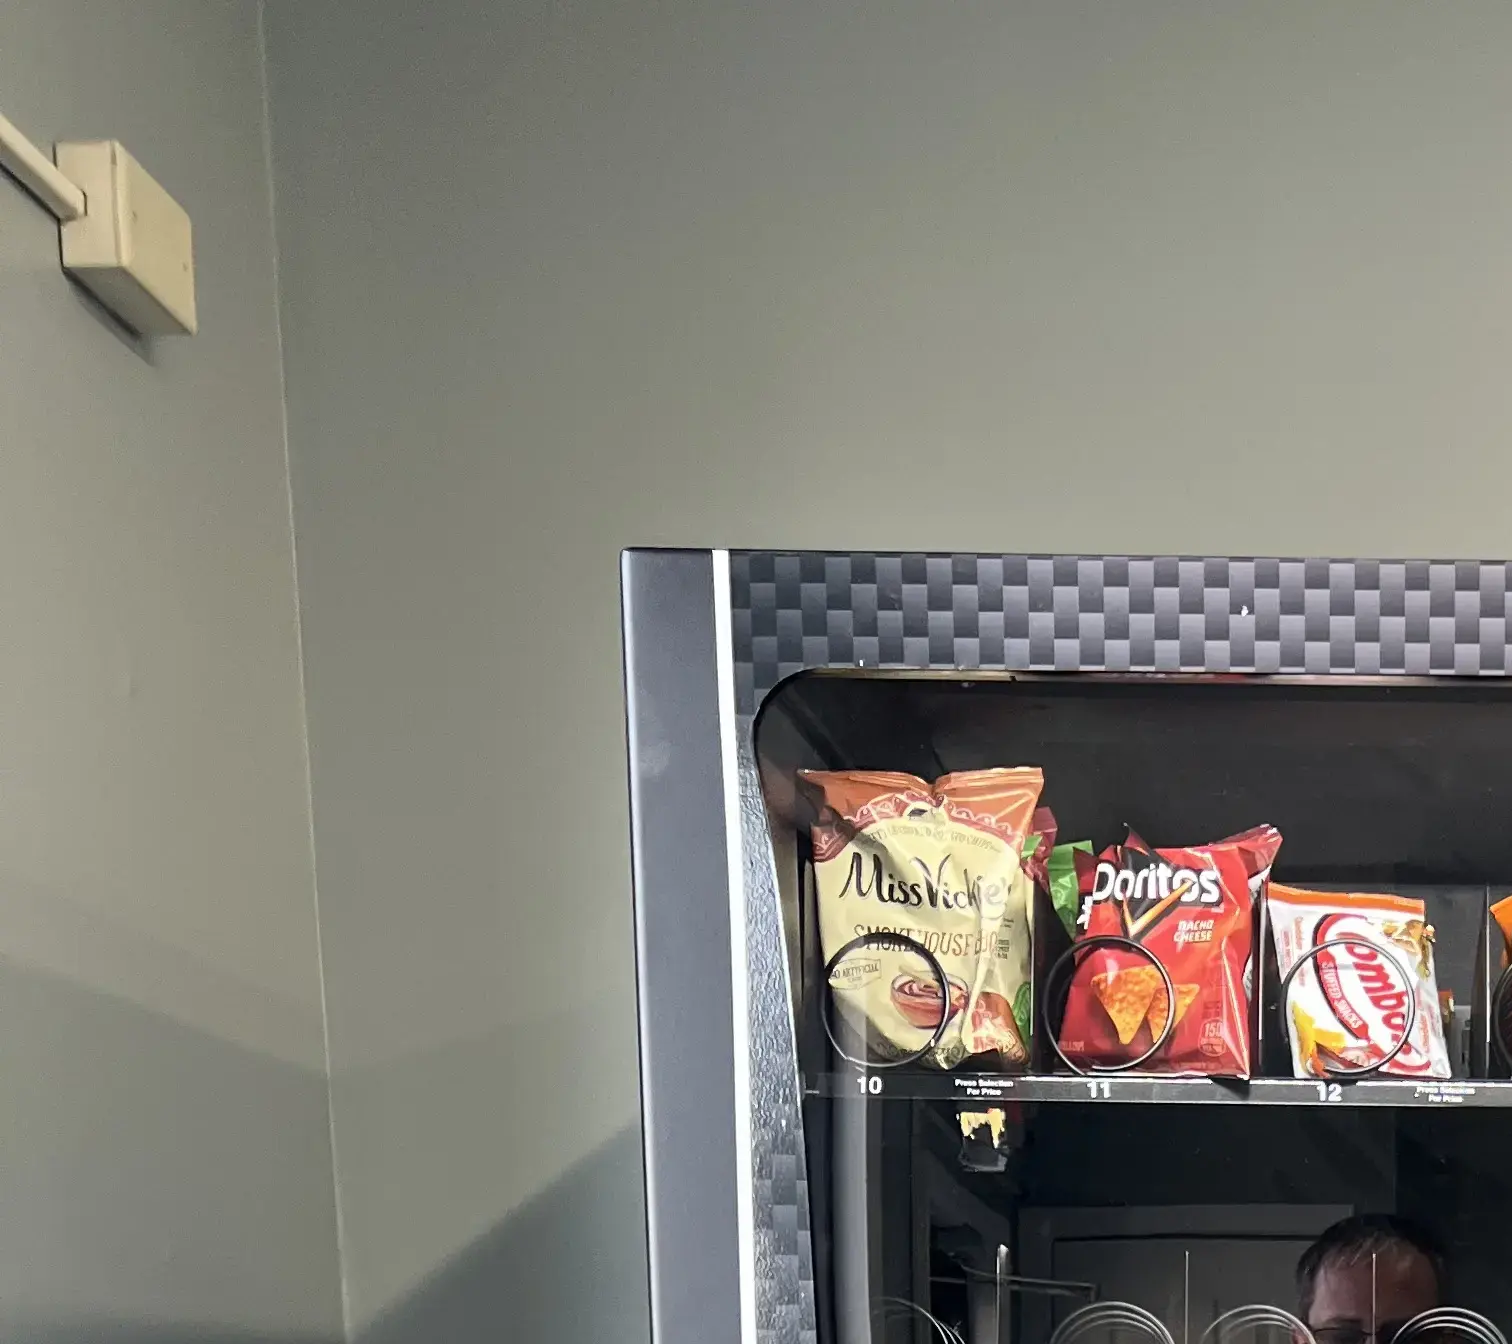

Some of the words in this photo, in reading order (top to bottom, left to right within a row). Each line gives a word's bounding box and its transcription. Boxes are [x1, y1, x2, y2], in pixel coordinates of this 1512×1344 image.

[912, 854, 1013, 910] Vickie'
[1092, 863, 1223, 903] Doritos
[1177, 919, 1215, 932] NACHO
[1173, 930, 1213, 943] CHEESE
[856, 1076, 883, 1095] 10
[955, 1079, 977, 1087] Press
[978, 1079, 1014, 1088] Selection
[966, 1088, 980, 1096] For
[981, 1088, 1002, 1097] Price
[1087, 1081, 1111, 1099] 11
[1317, 1084, 1343, 1102] 12
